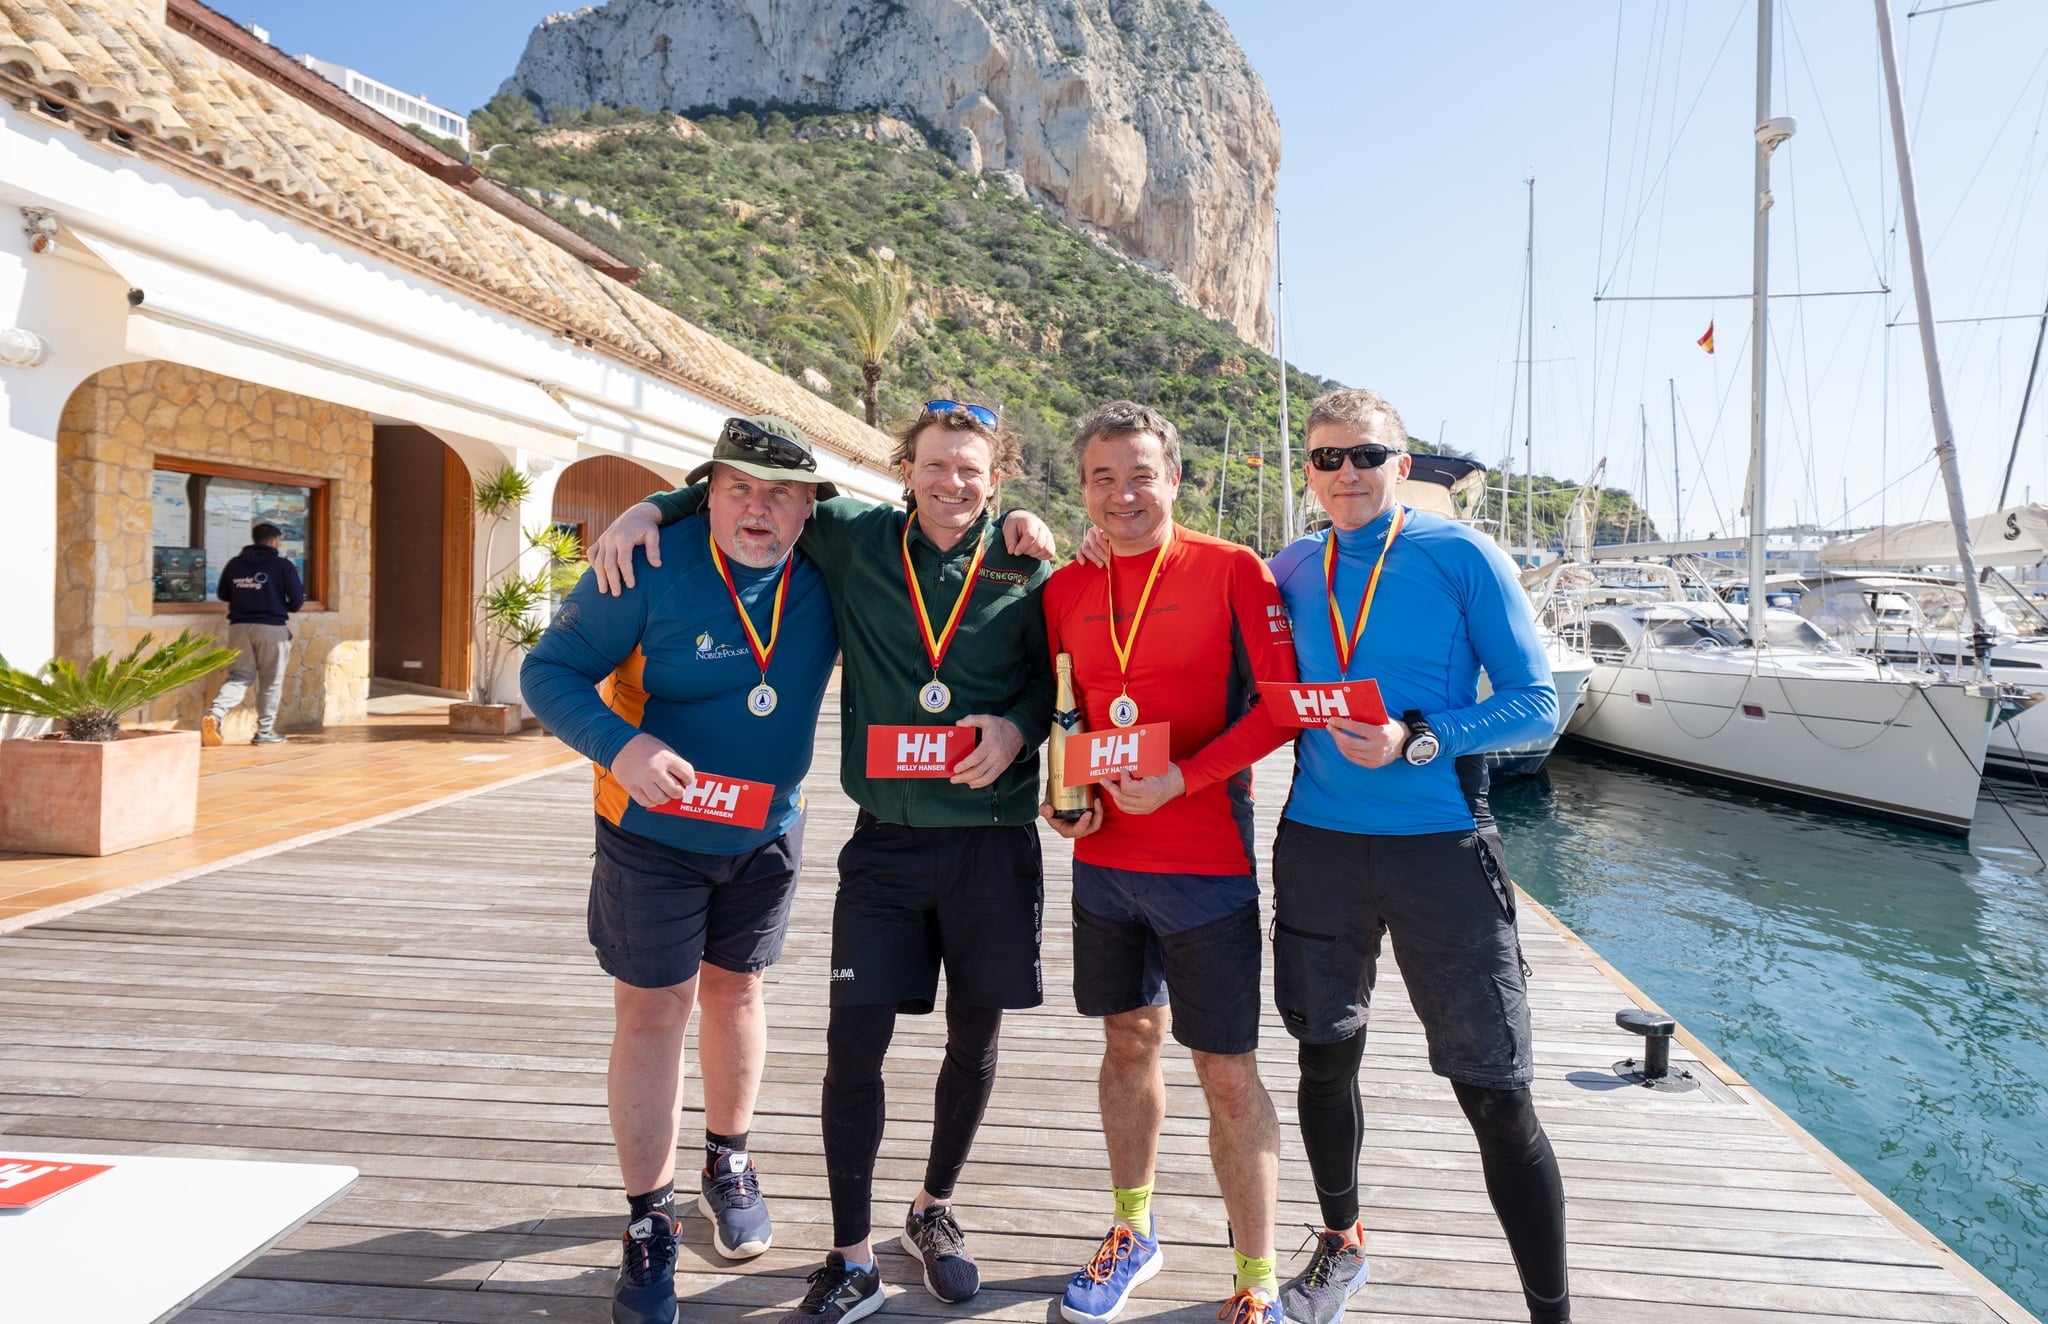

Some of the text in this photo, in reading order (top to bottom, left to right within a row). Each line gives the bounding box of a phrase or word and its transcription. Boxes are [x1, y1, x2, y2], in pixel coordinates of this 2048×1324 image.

[1290, 689, 1350, 717] HH
[897, 733, 947, 763] HH
[1090, 732, 1139, 769] HH
[1089, 767, 1110, 777] HELLY
[680, 804, 734, 819] HELLY HANSEN
